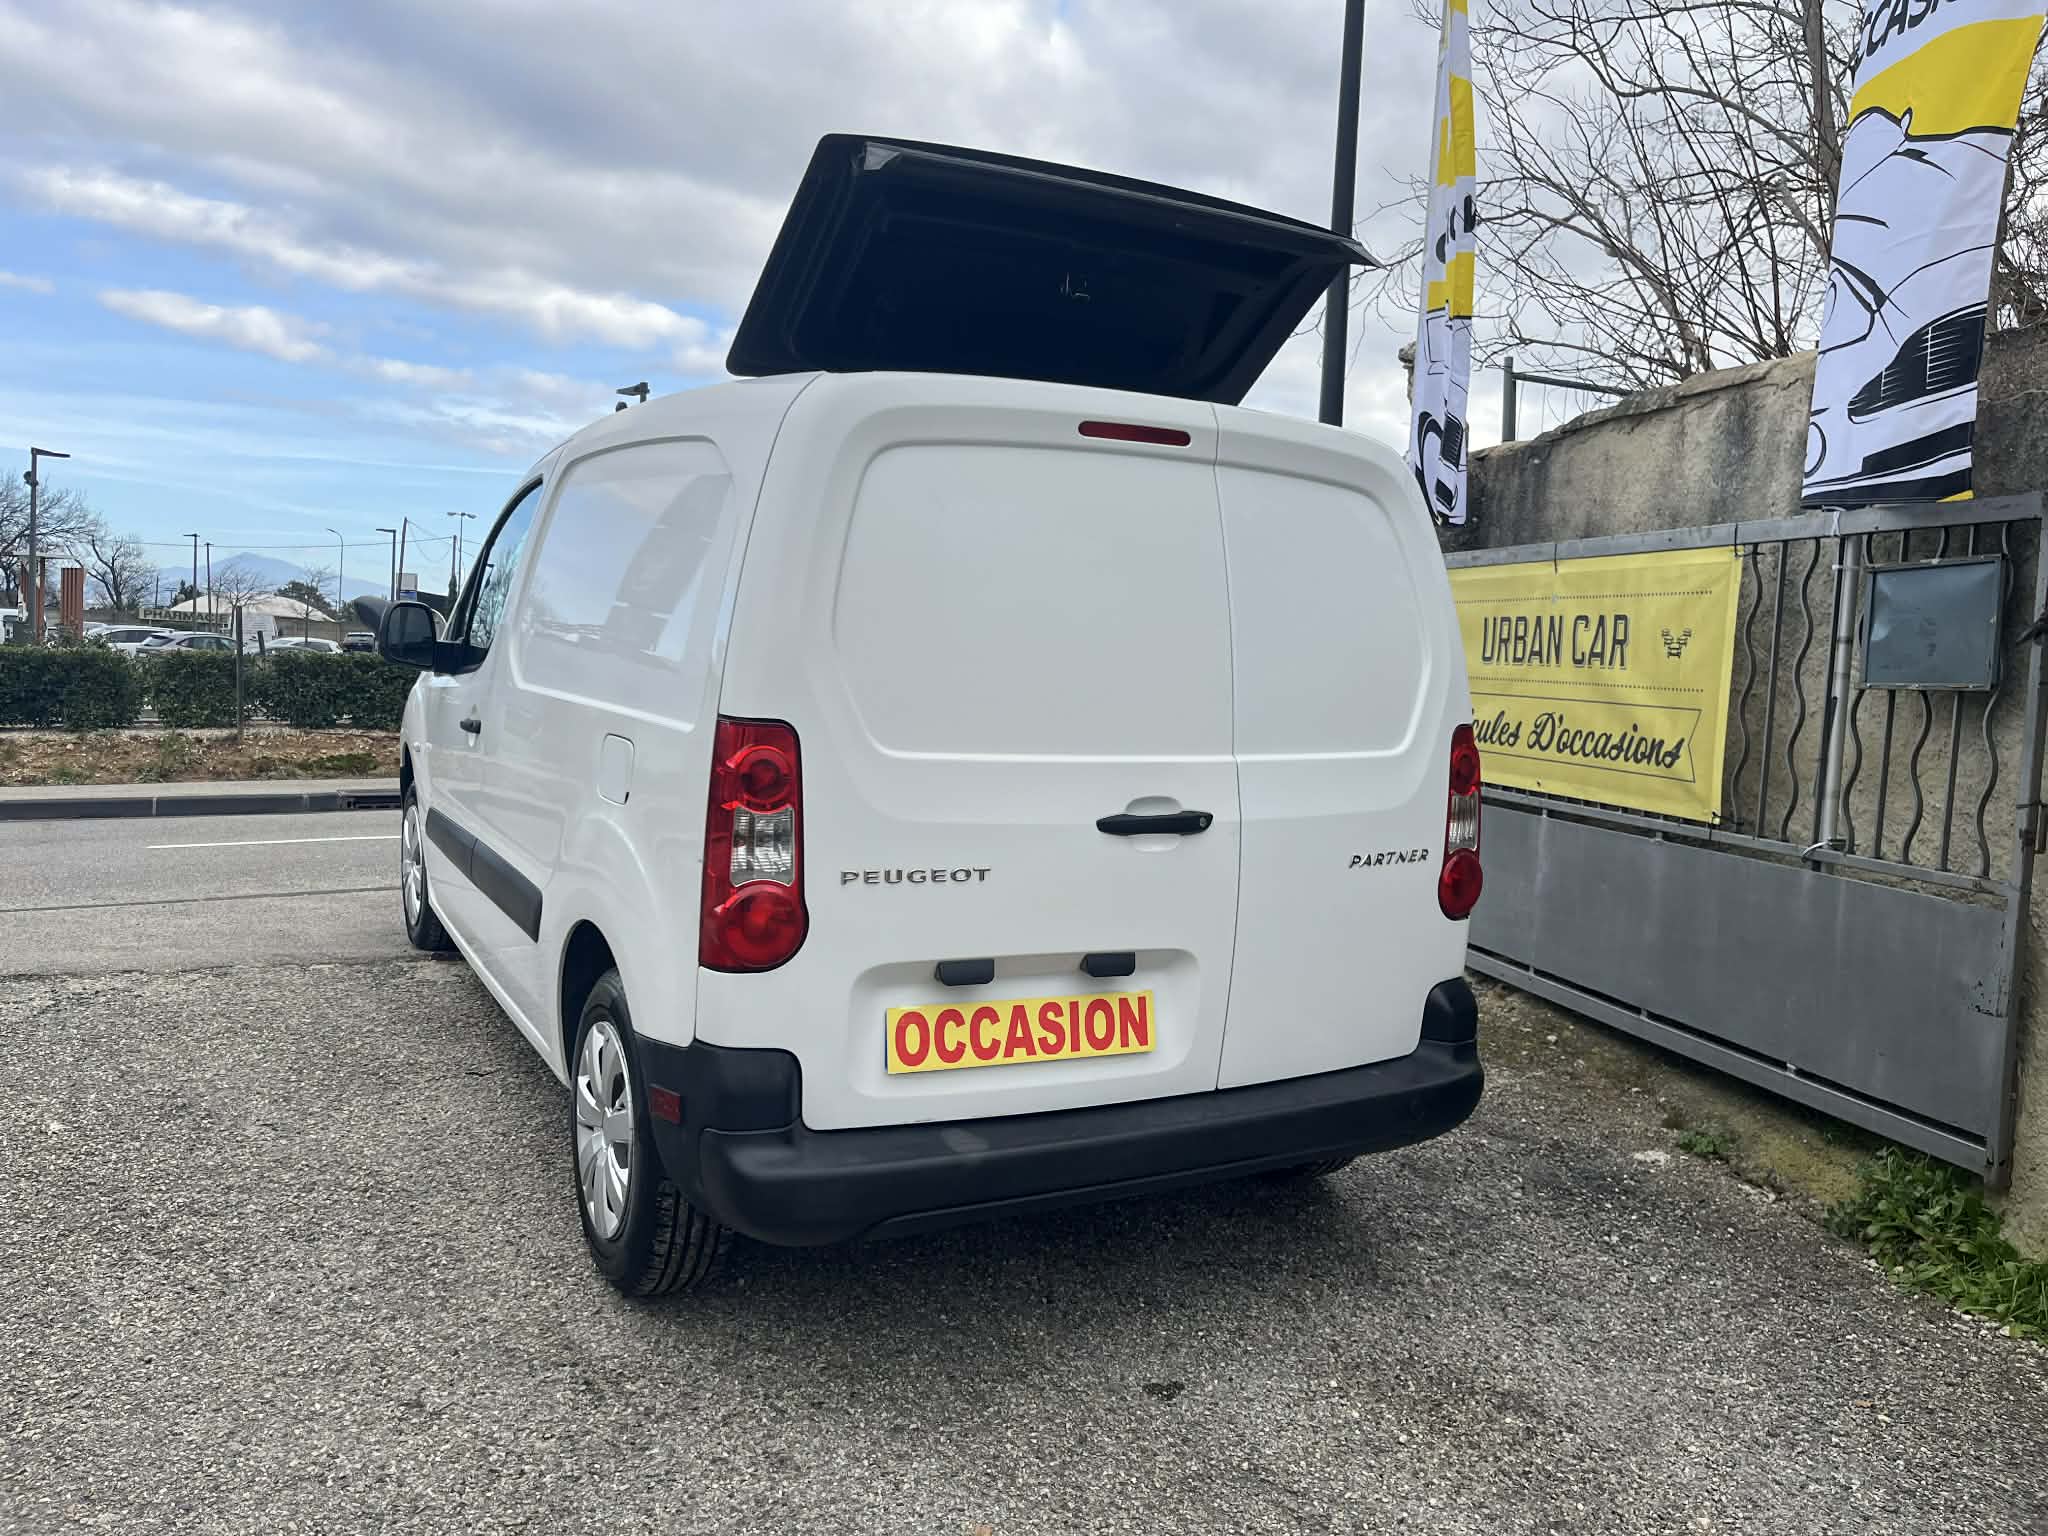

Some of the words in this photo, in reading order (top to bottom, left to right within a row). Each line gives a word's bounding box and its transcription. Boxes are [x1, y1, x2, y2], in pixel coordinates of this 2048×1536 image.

[1481, 614, 1564, 666] URBAN
[1571, 613, 1630, 669] CAR
[1472, 708, 1523, 748] cules
[1526, 711, 1686, 769] D'occasions
[840, 867, 992, 886] PEUGEOT
[1348, 848, 1430, 869] PARTNER
[894, 995, 1150, 1067] OCCASION
